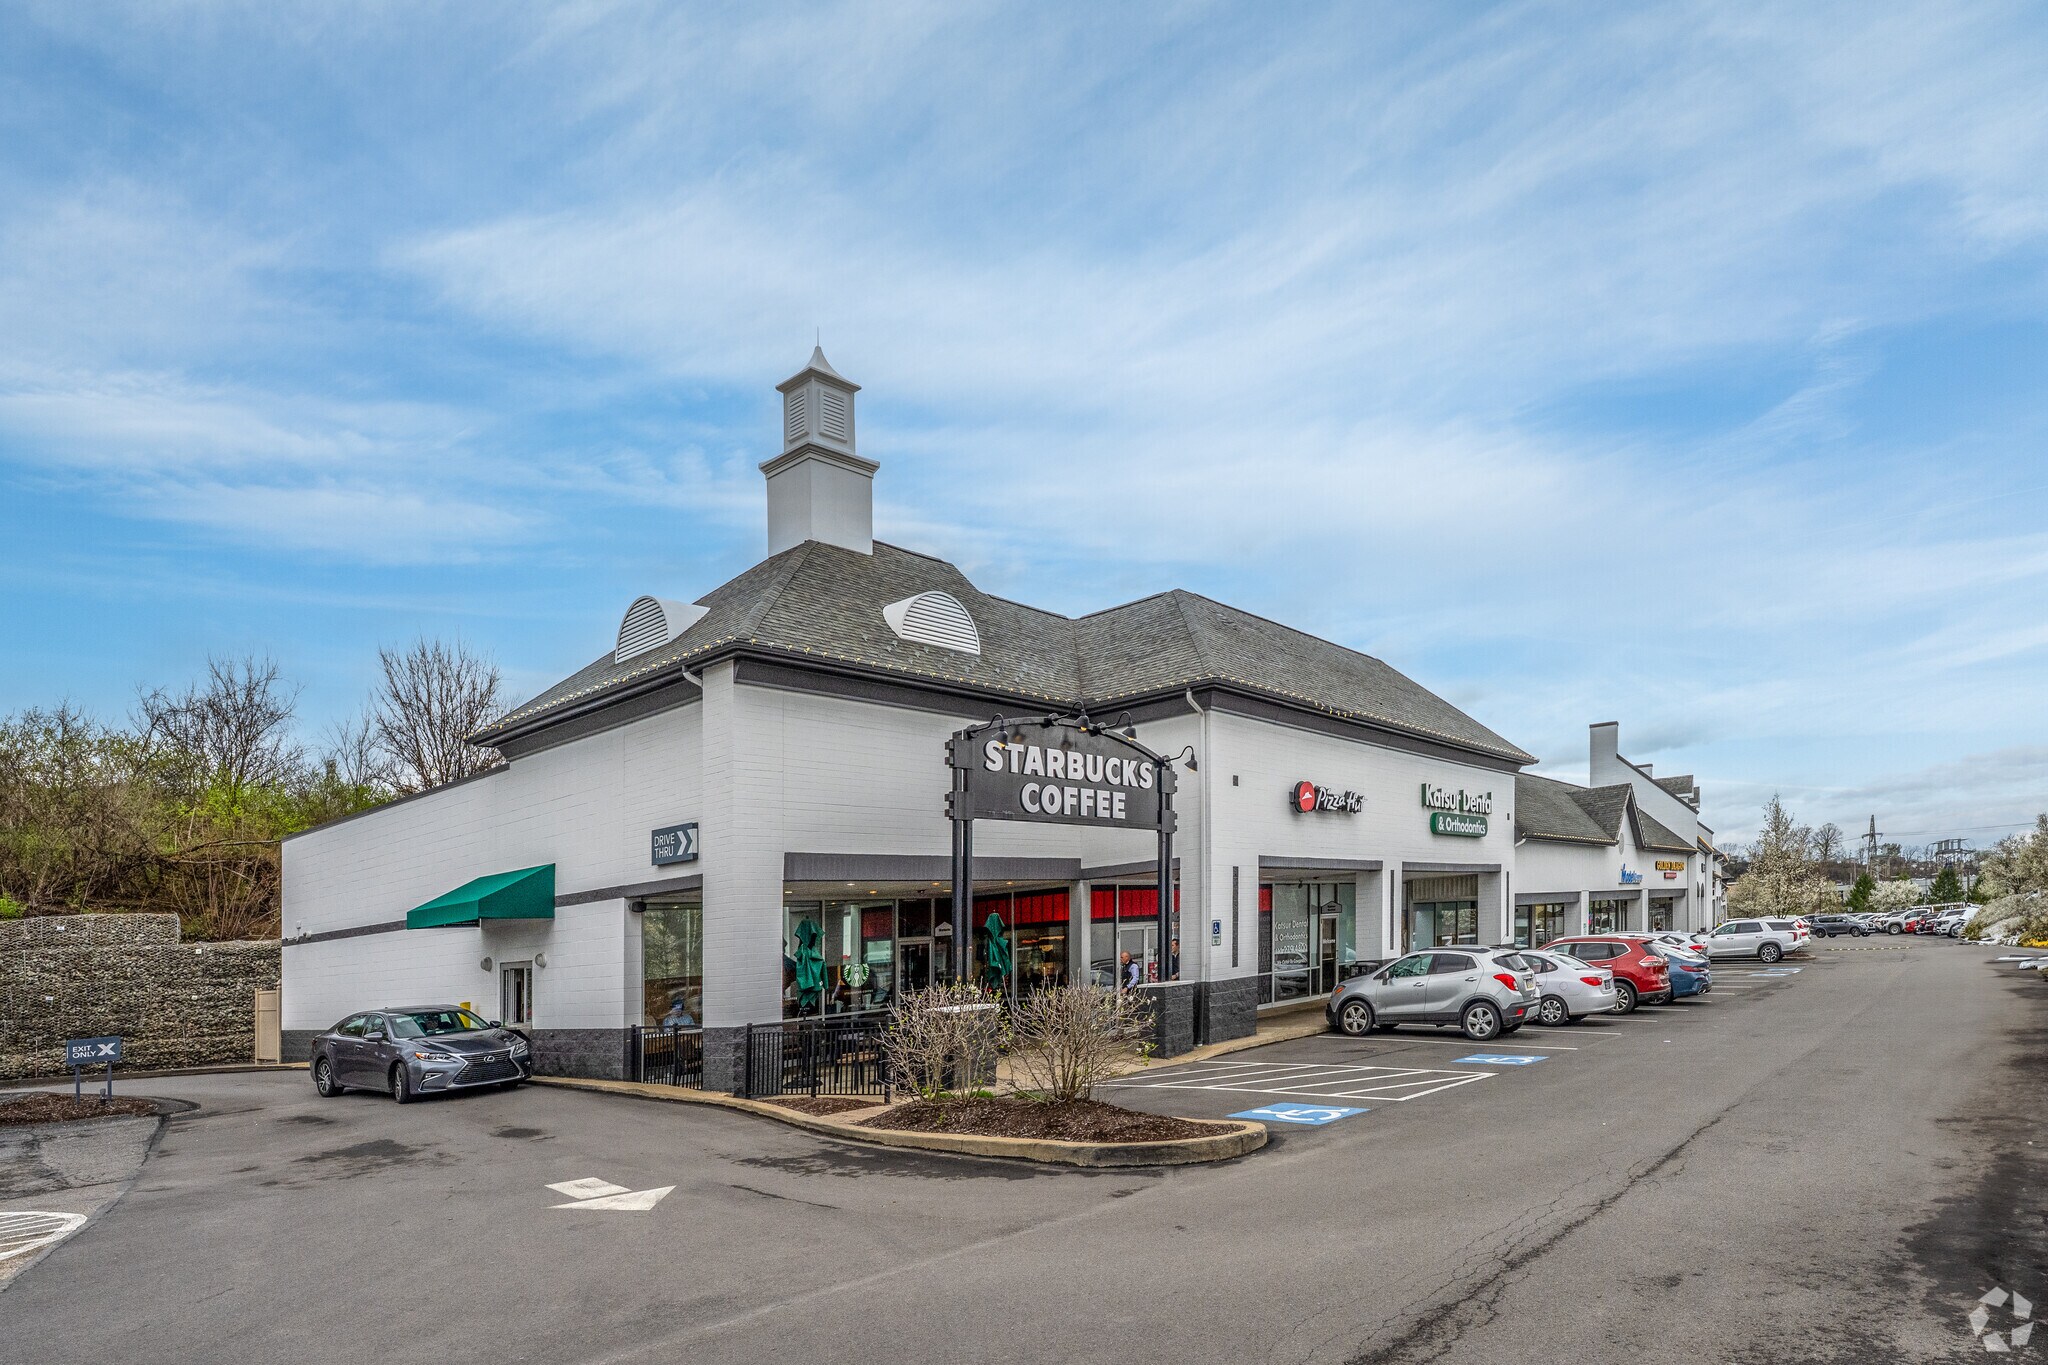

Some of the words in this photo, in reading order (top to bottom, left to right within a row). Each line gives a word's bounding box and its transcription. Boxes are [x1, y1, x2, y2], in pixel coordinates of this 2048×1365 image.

[984, 740, 1153, 789] STARBUCKS
[1021, 782, 1126, 819] COFFEE
[1315, 786, 1346, 811] Pizza
[1346, 791, 1367, 814] Hut
[1423, 783, 1460, 813] Katsur
[1462, 790, 1493, 815] Dental
[1438, 816, 1445, 831] &
[1446, 816, 1486, 834] Orthodontics
[654, 832, 675, 847] DRIVE
[654, 845, 674, 859] THRU
[72, 1044, 92, 1053] EXIT
[72, 1050, 97, 1059] ONLY
